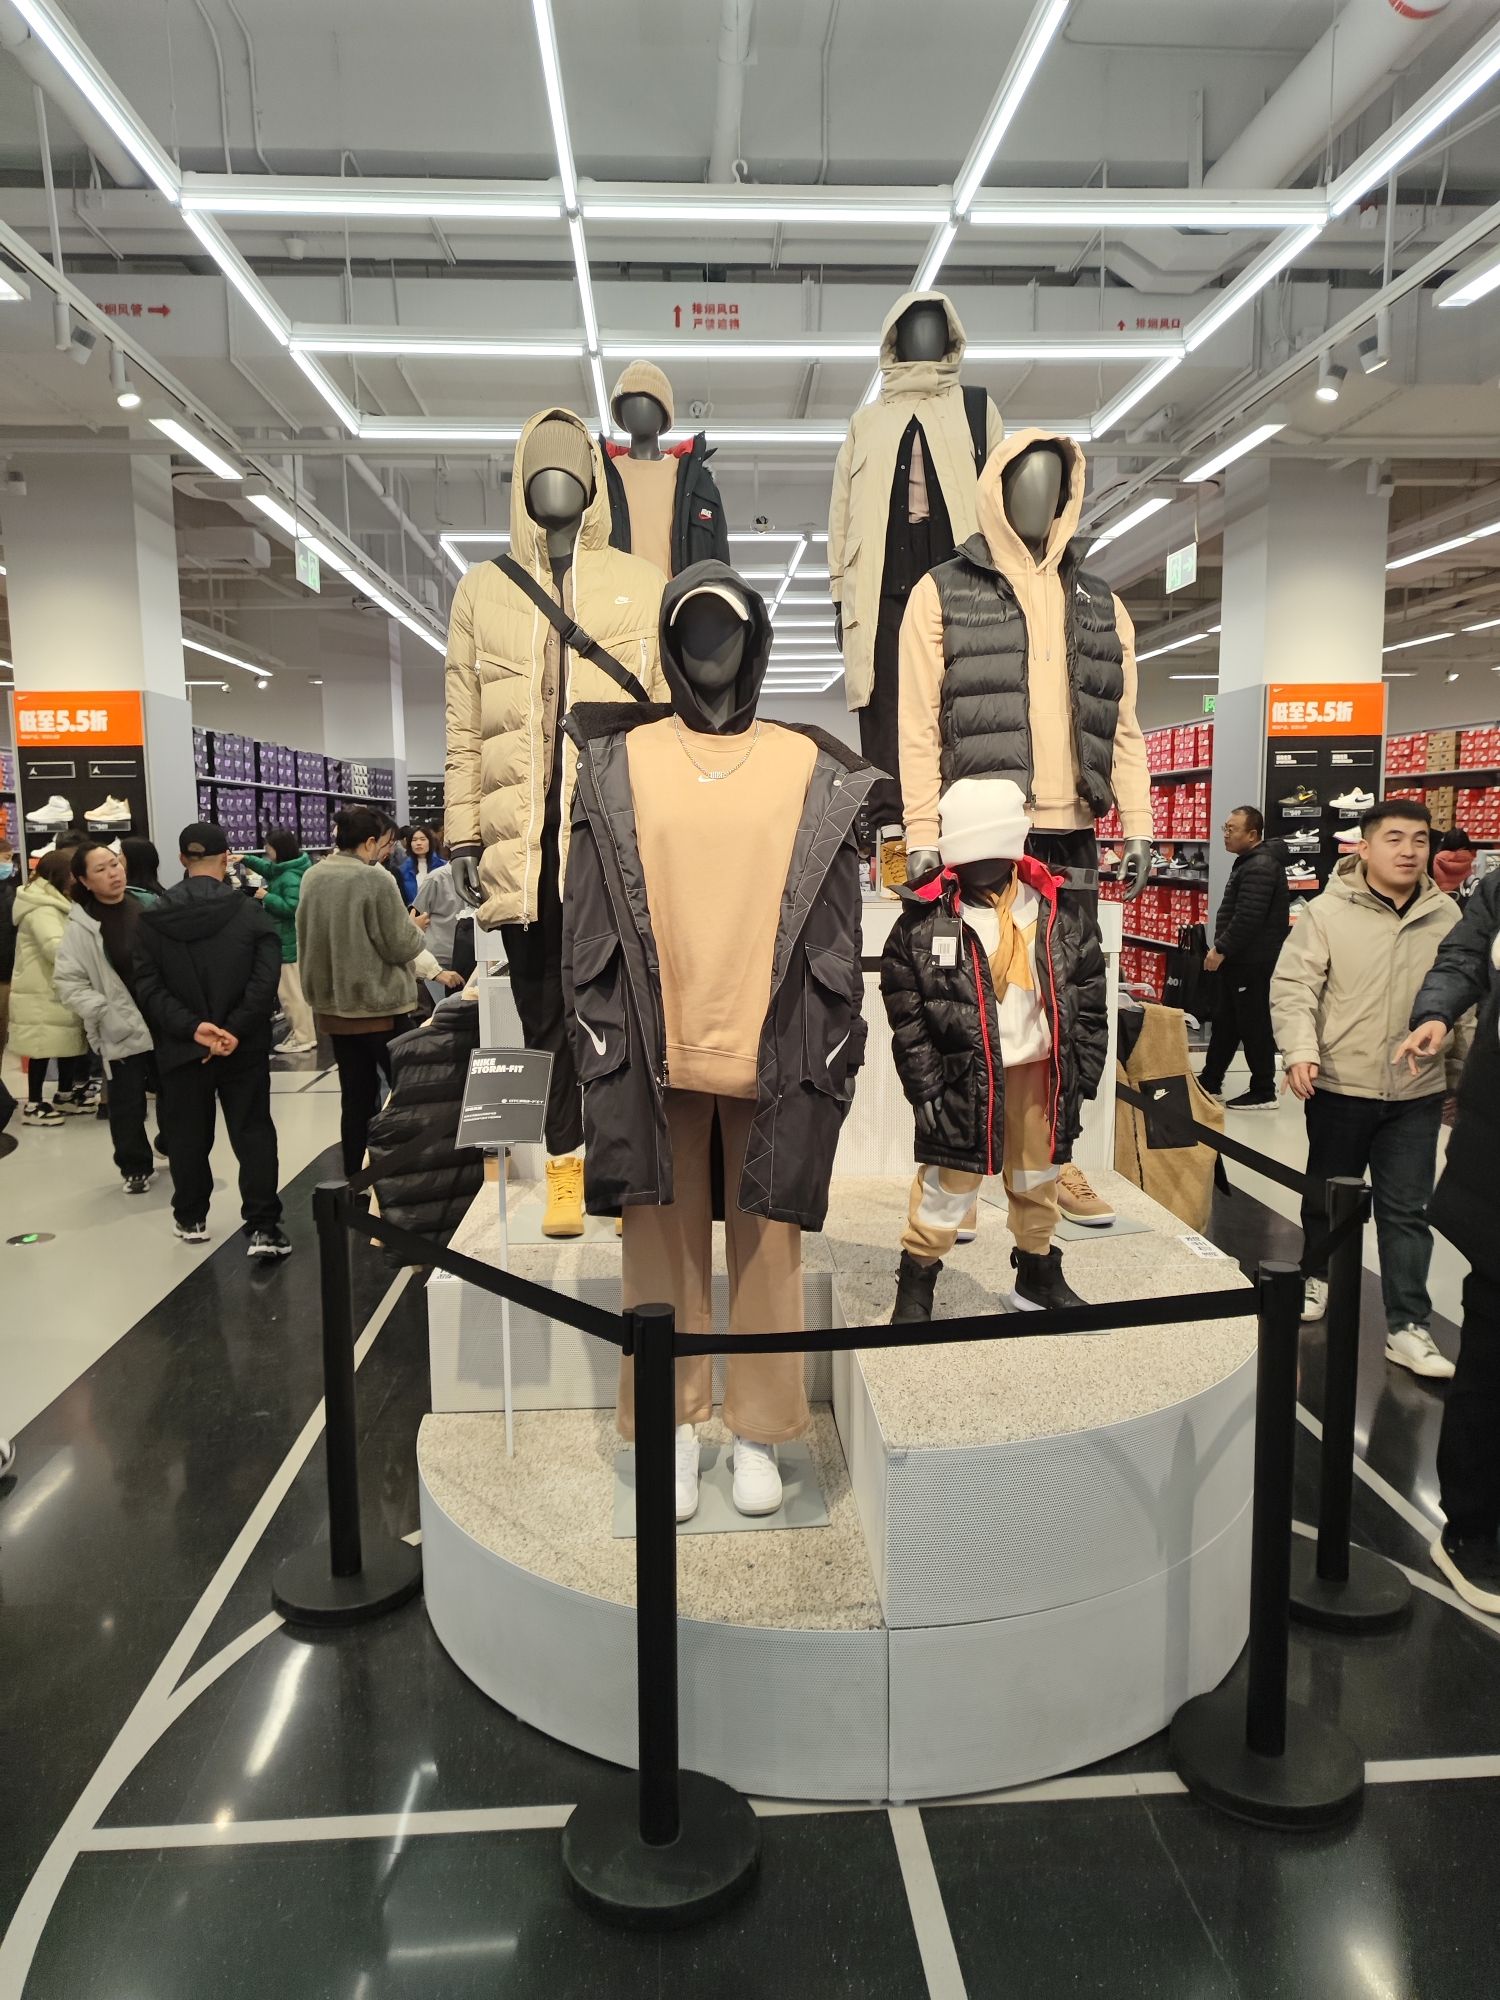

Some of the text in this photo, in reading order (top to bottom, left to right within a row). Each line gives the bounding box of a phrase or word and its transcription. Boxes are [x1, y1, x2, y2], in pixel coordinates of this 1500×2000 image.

[1272, 701, 1353, 723] 低至5.5折
[20, 709, 108, 732] 低至5.5折
[470, 1064, 524, 1075] STORM-FIT
[473, 1057, 496, 1067] NIKE
